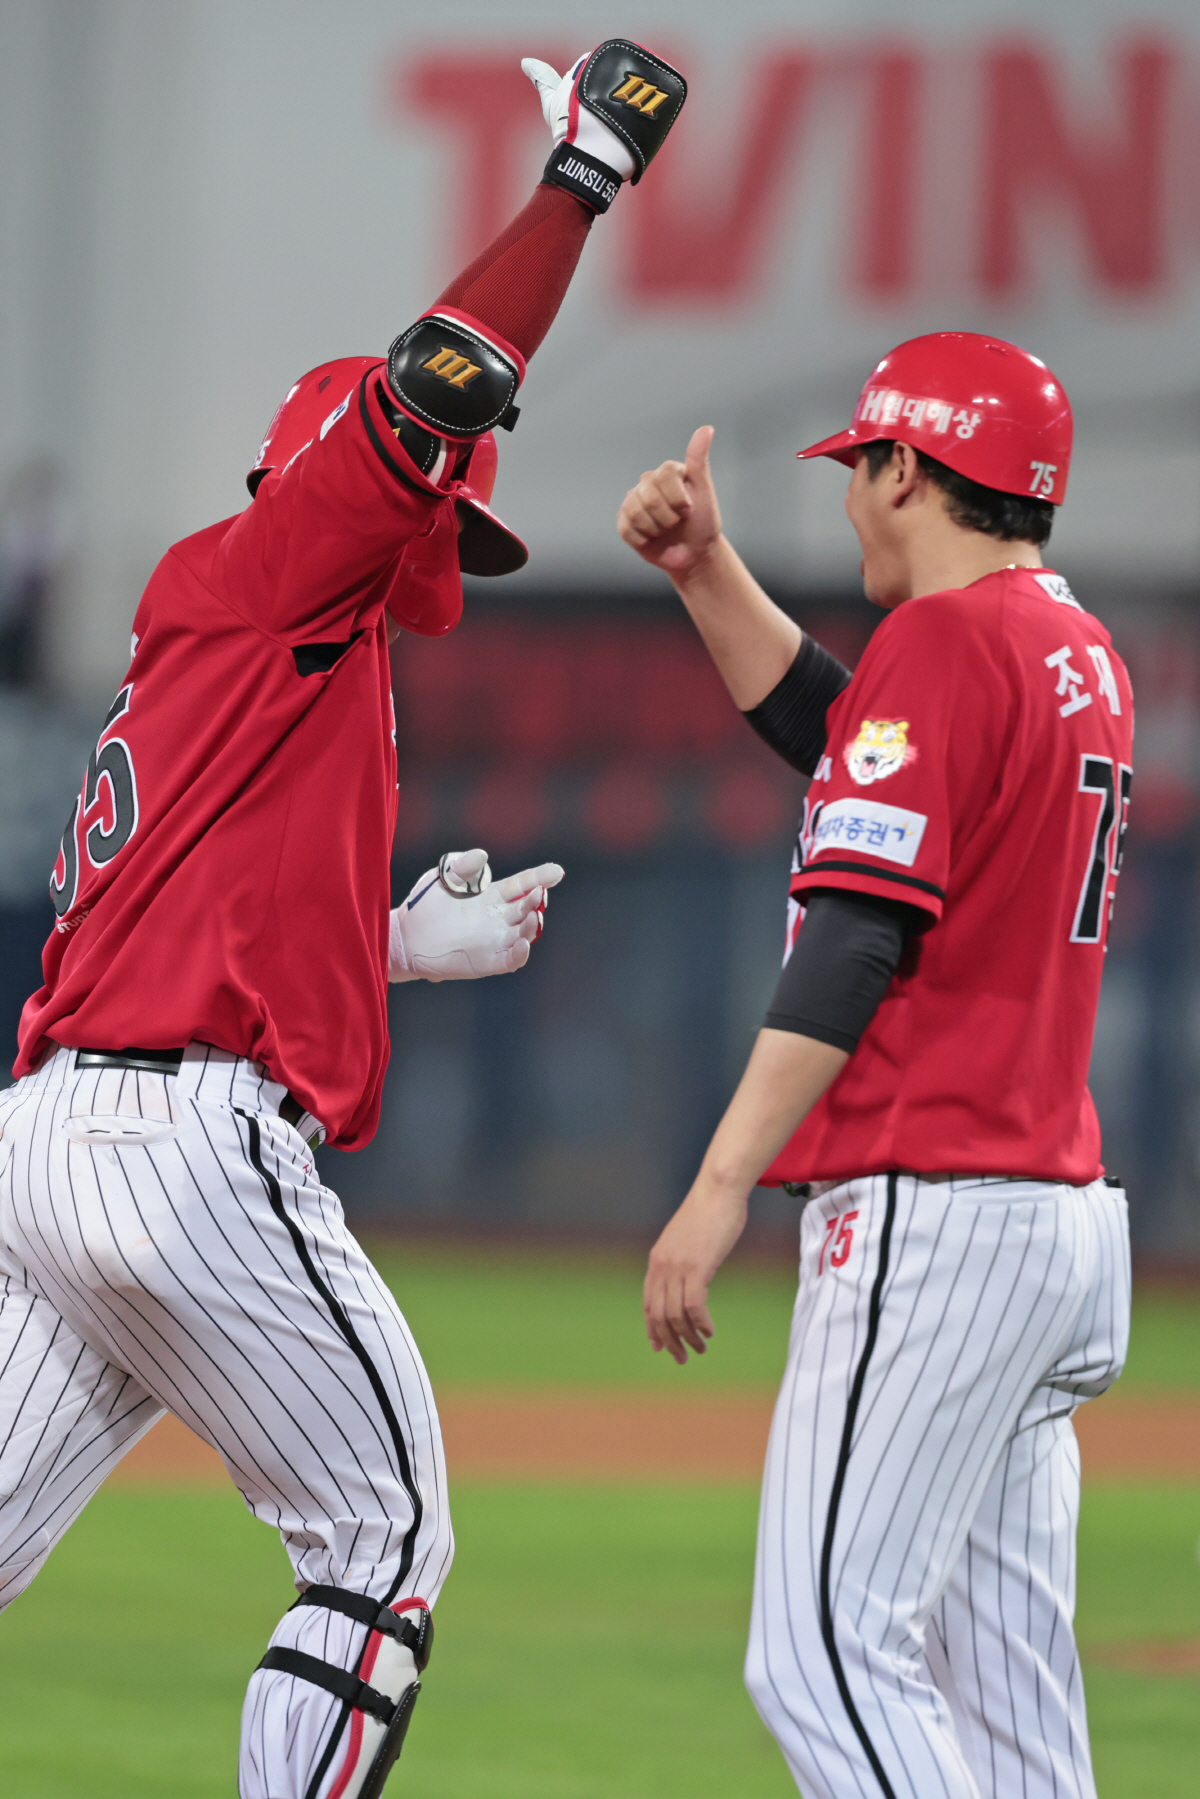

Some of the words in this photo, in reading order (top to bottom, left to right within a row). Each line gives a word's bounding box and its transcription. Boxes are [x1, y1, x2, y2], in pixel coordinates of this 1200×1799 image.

[557, 157, 607, 193] JUNSU
[601, 181, 618, 203] 55
[1029, 461, 1057, 495] 75
[1044, 645, 1128, 718] 조재
[818, 1211, 859, 1276] 75
